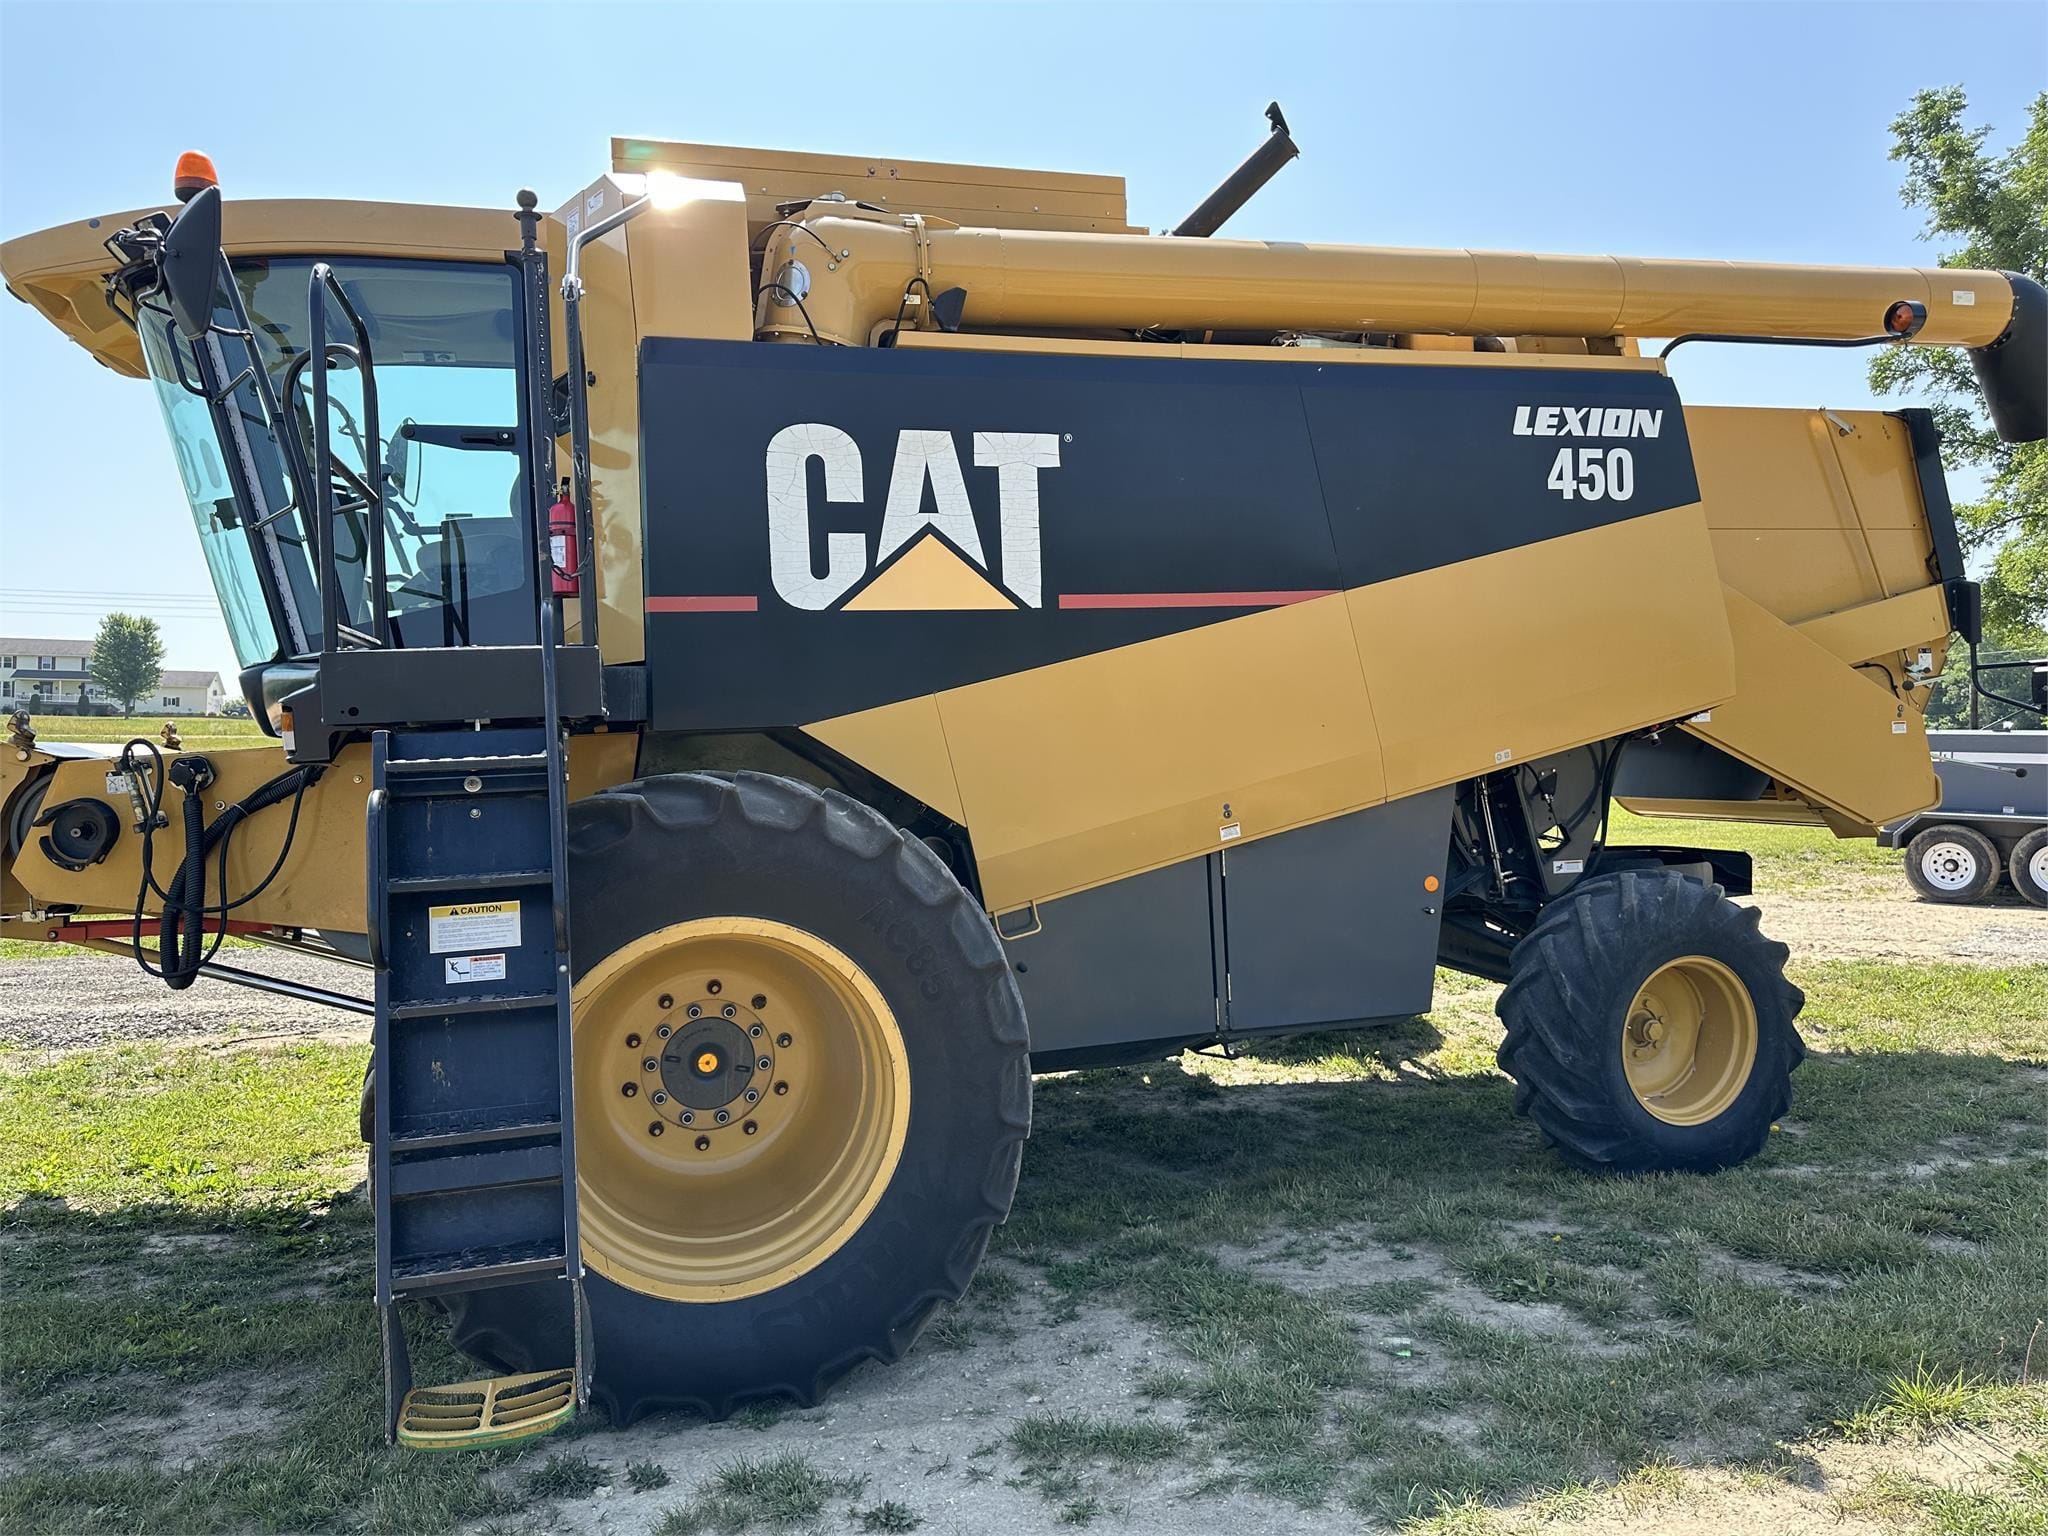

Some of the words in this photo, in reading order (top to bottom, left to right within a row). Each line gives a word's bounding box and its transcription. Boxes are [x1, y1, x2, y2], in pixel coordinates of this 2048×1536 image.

[1512, 405, 1663, 438] LEXION
[1547, 447, 1634, 502] 450
[765, 422, 1061, 611] CAT
[460, 904, 502, 915] CAUTION
